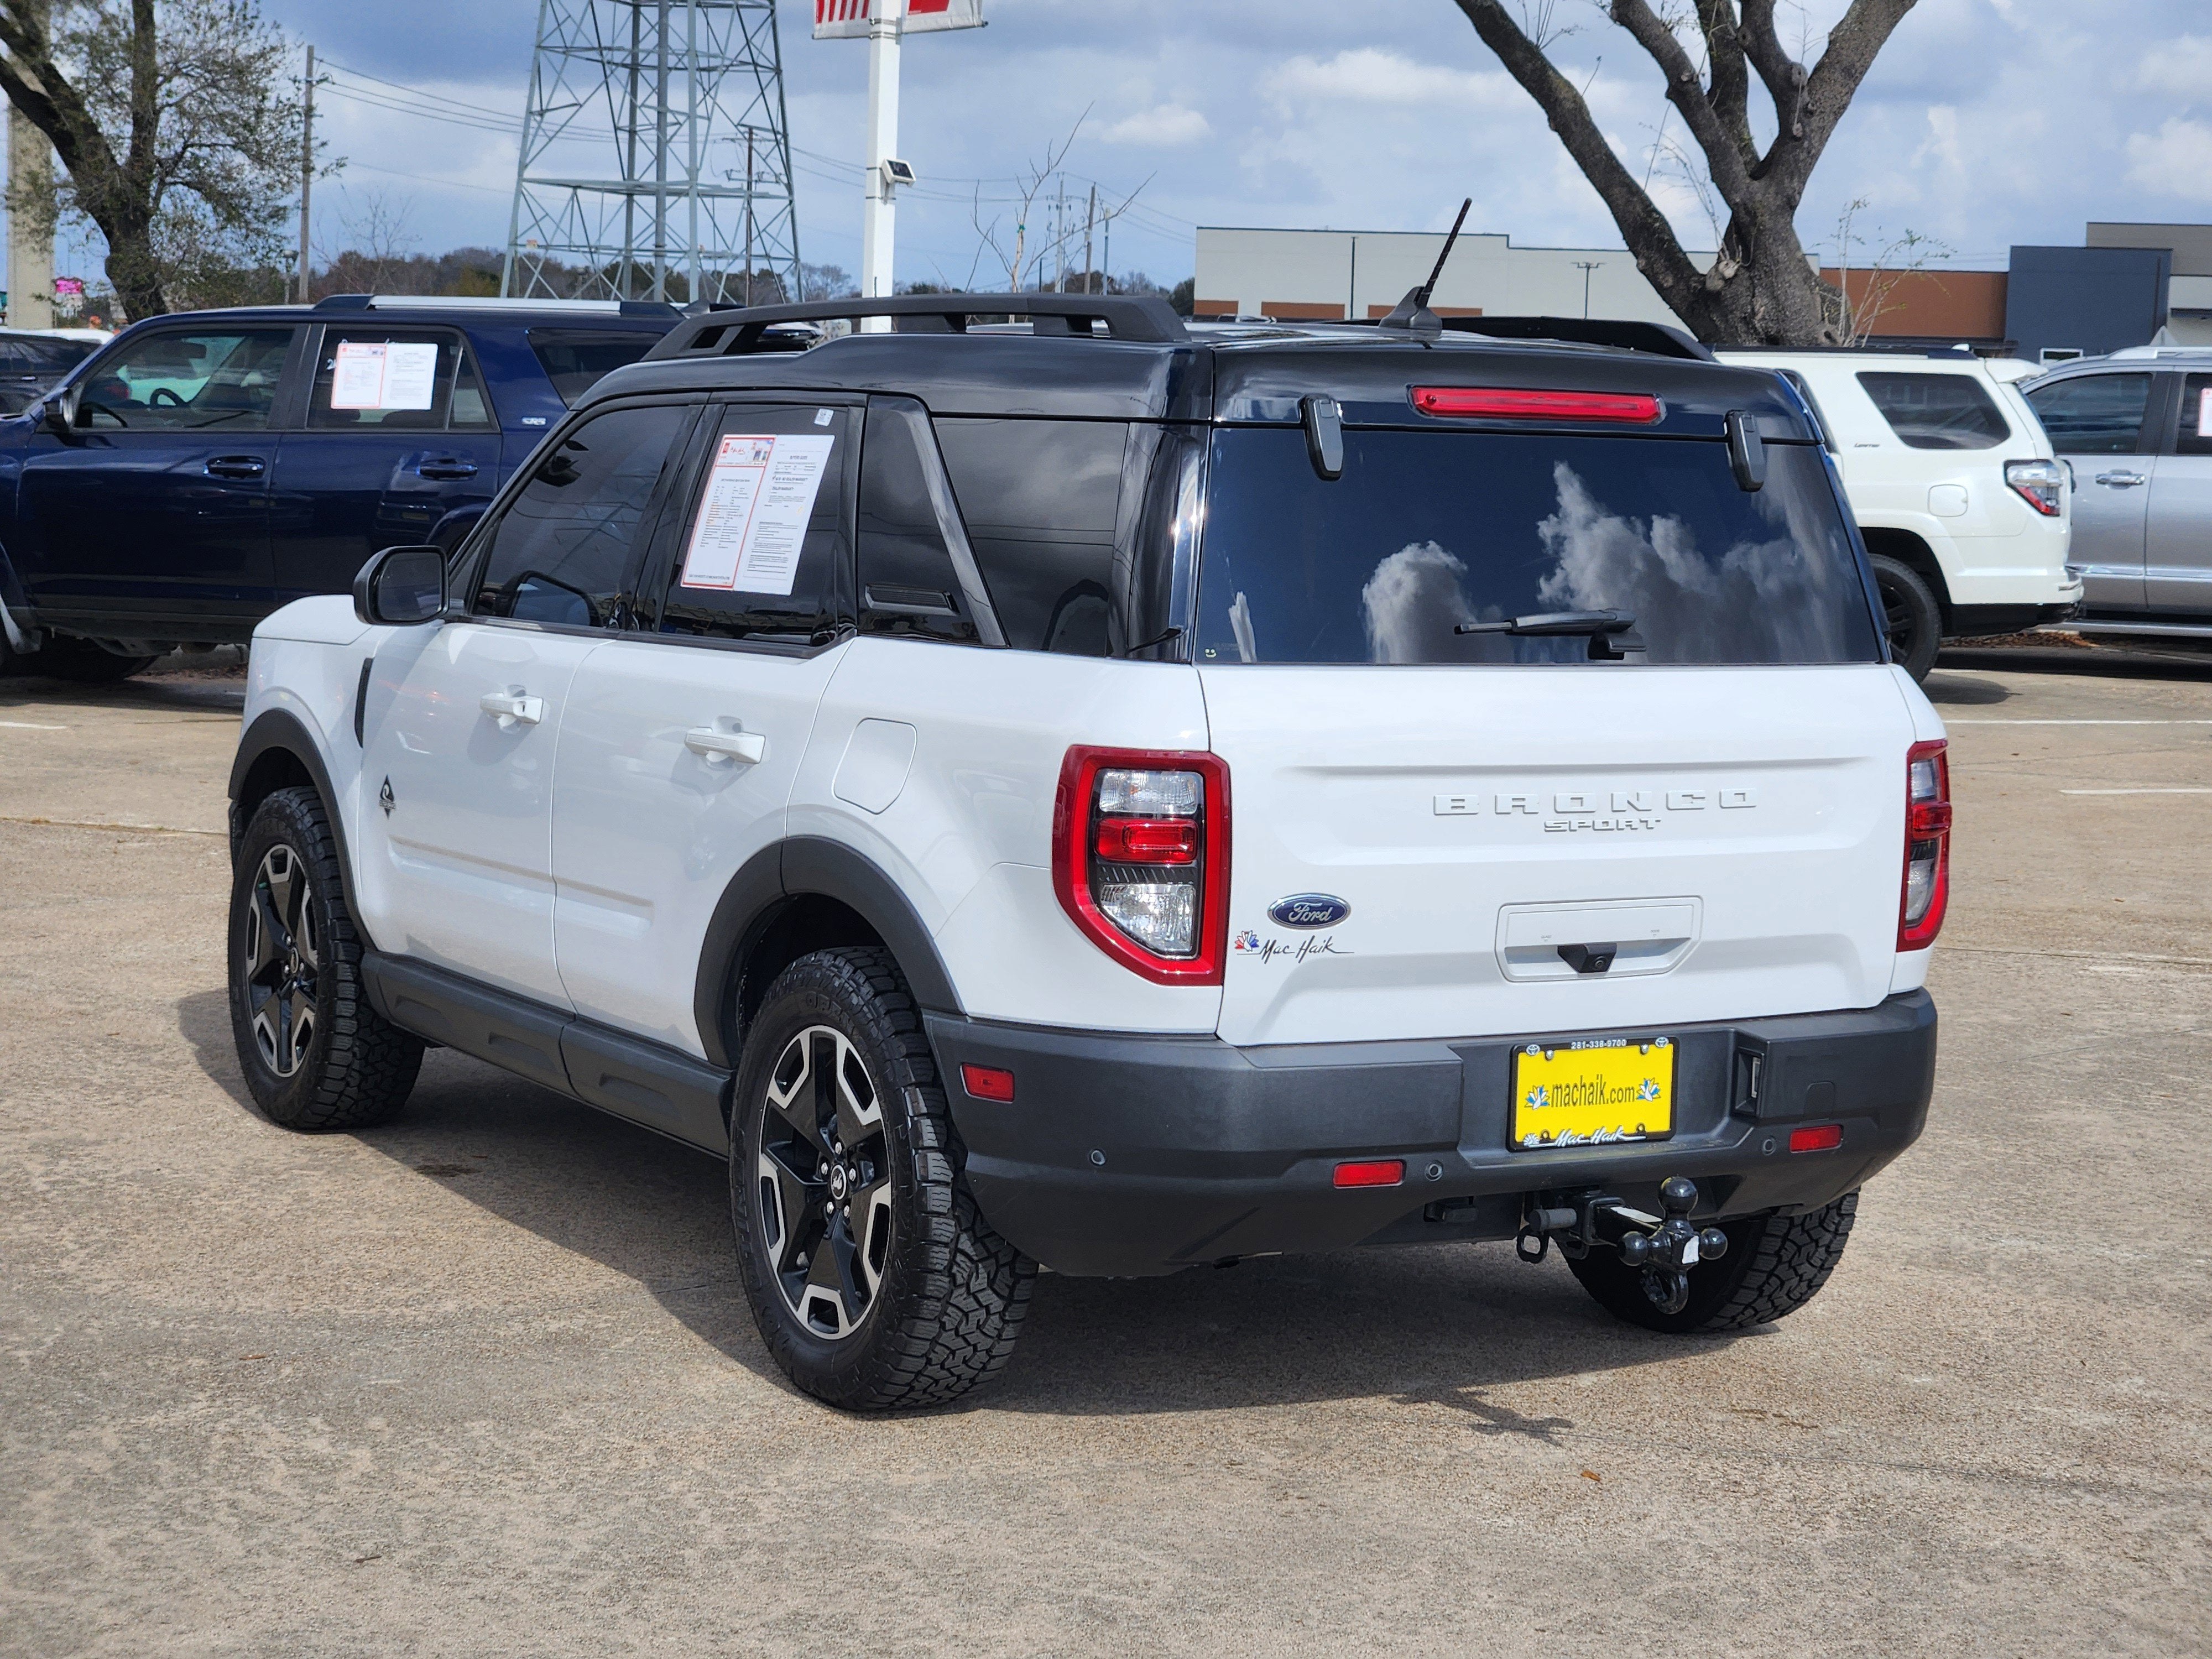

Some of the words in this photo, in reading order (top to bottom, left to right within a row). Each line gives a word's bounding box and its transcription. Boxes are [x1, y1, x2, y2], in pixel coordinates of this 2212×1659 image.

[1433, 788, 1757, 816] BRONCO
[1544, 818, 1662, 832] SPORT
[1288, 902, 1333, 923] Ford
[1260, 939, 1295, 964] Mac
[1295, 935, 1338, 964] Haik
[1571, 1039, 1627, 1049] 281-338-9700
[1551, 1074, 1635, 1108] machaik.com
[1554, 1128, 1589, 1147] Mac
[1590, 1125, 1631, 1145] Haik
